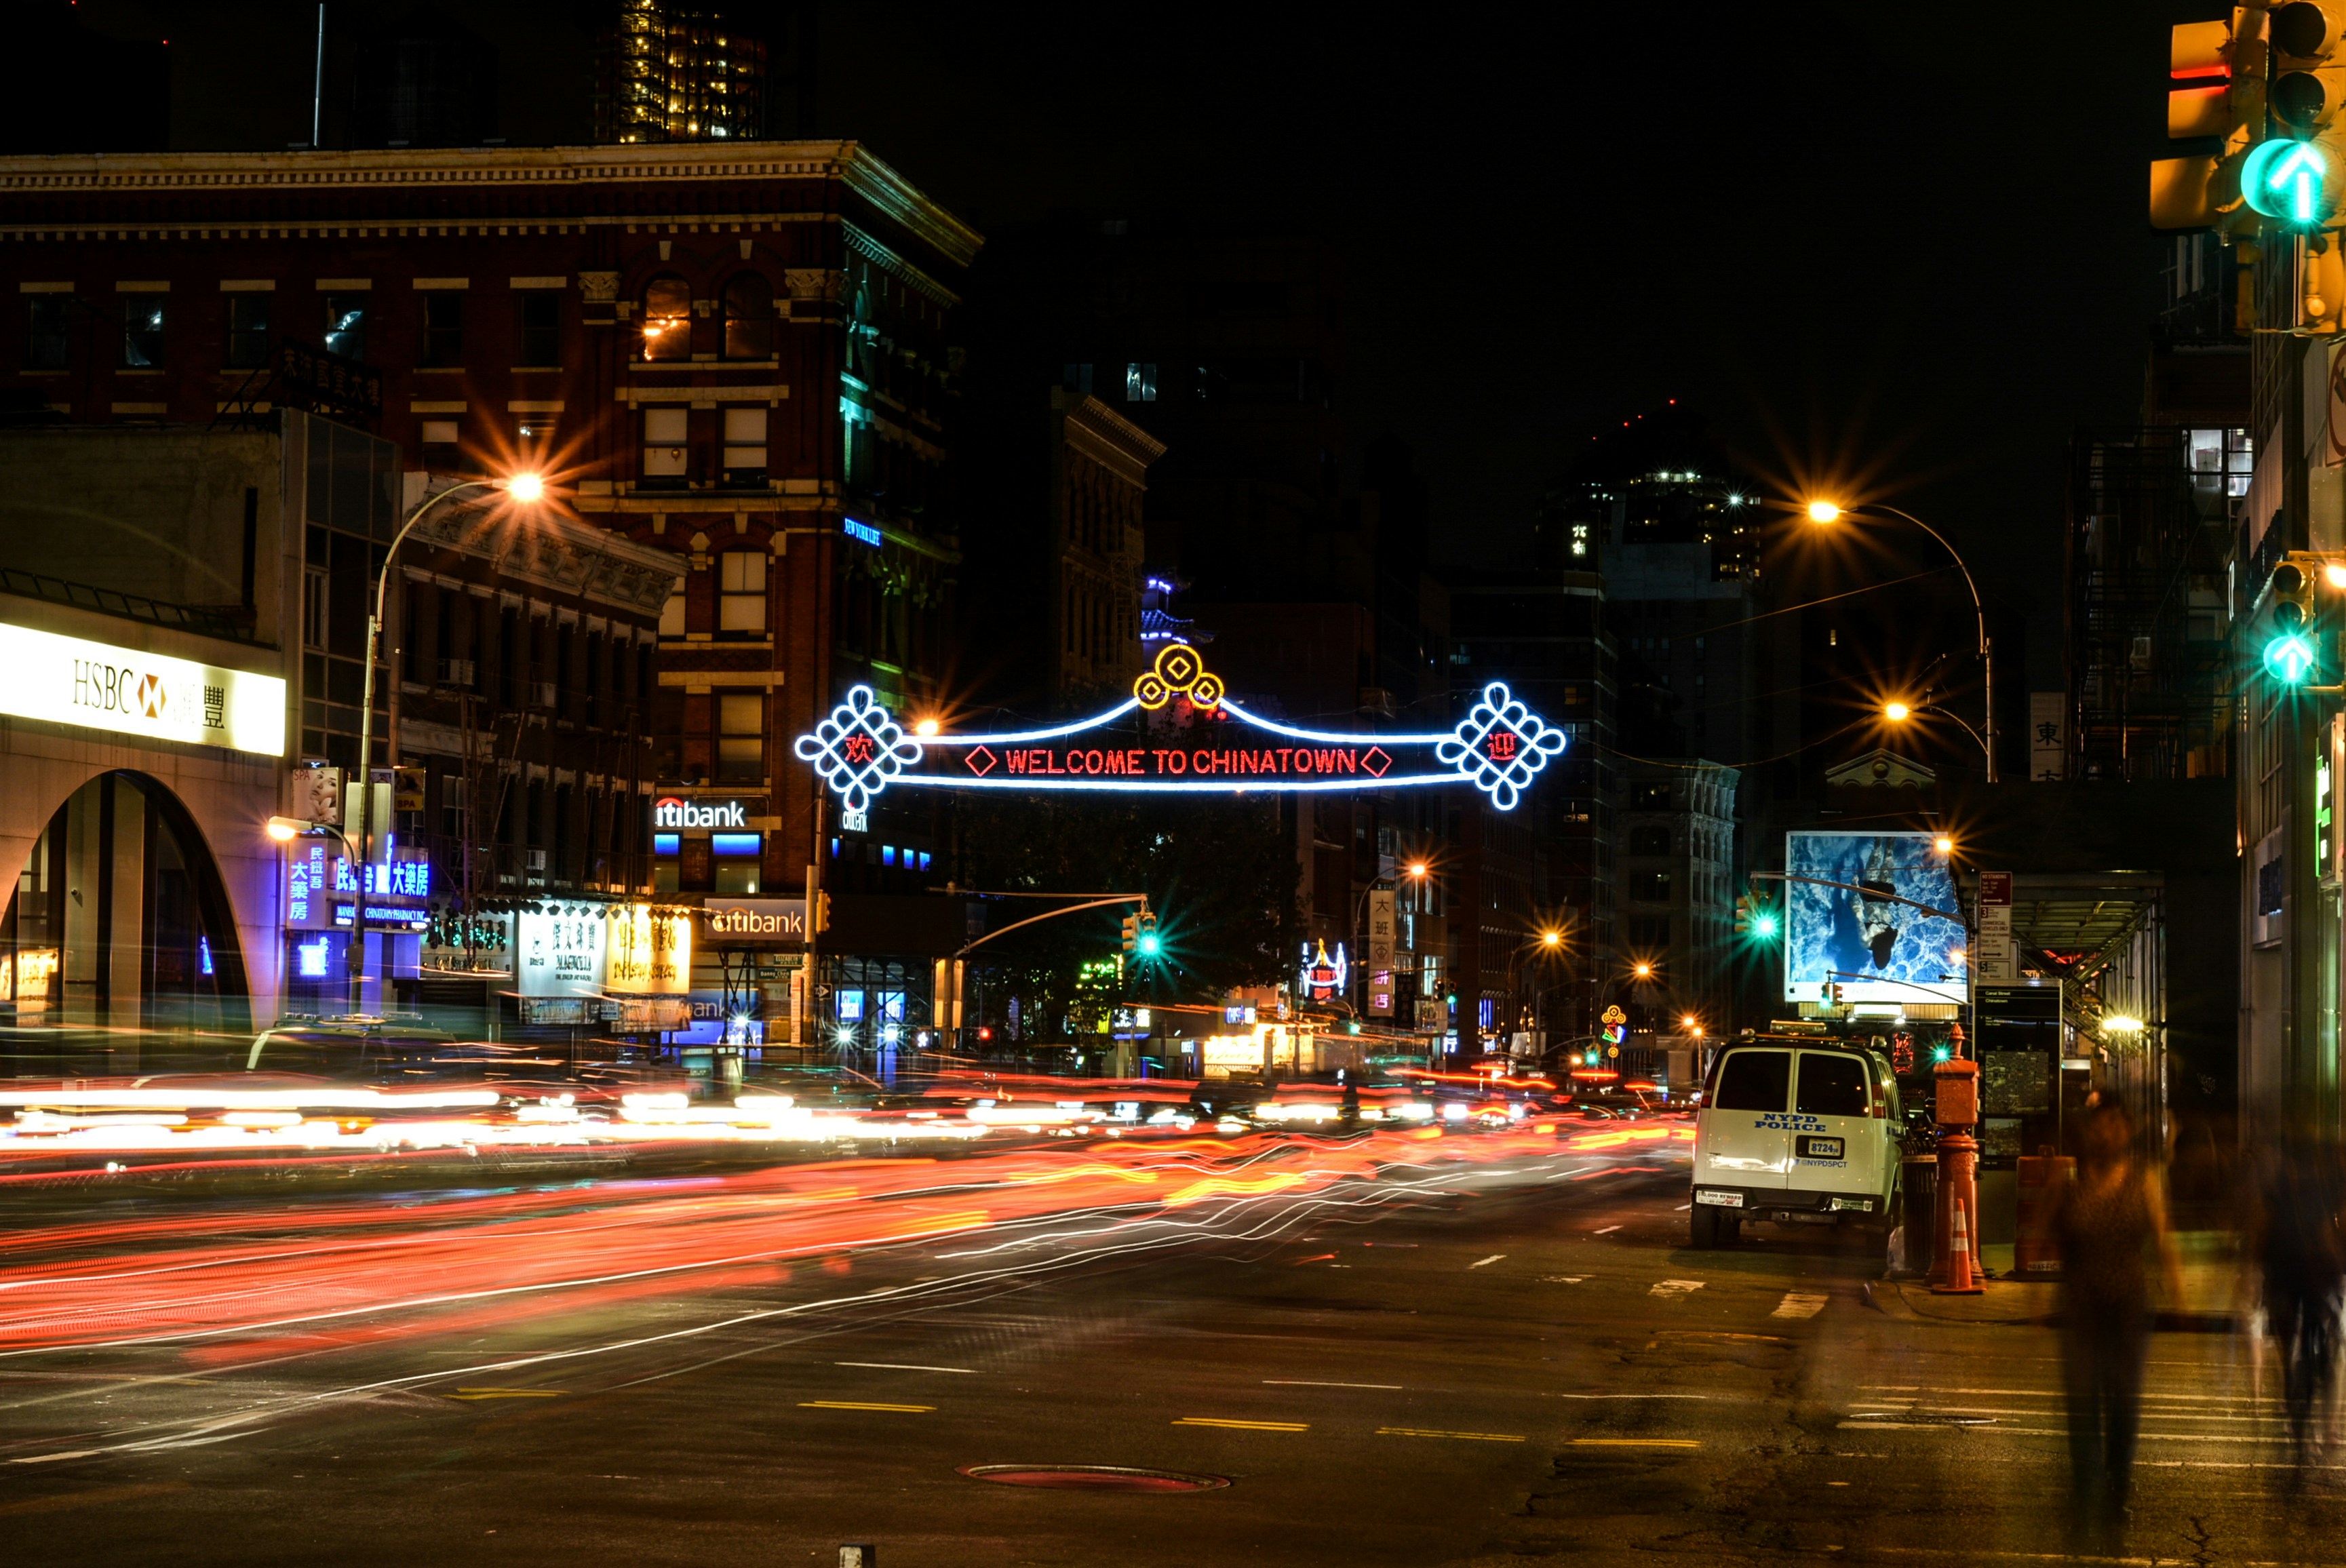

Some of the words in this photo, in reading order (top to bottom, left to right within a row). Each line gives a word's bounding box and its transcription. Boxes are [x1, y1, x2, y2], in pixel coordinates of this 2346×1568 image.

[73, 659, 134, 713] HSBC
[172, 682, 225, 729] 豐
[844, 732, 874, 763] 欢
[1487, 733, 1517, 760] 迎
[1005, 749, 1145, 775] WELCOME
[1152, 749, 1186, 774] TO
[1192, 749, 1356, 774] CHINATOWN
[294, 769, 310, 781] SPA
[397, 800, 416, 808] SPA
[657, 799, 745, 827] itibank
[289, 861, 308, 920] 大藥房
[713, 909, 802, 933] citibank
[1982, 908, 1987, 917] 3
[1981, 962, 1987, 971] 5
[1754, 1121, 1826, 1132] POLICE
[1763, 1114, 1818, 1123] NYPD
[1812, 1143, 1833, 1153] 8724
[1801, 1159, 1848, 1168] @NYPD5PCT
